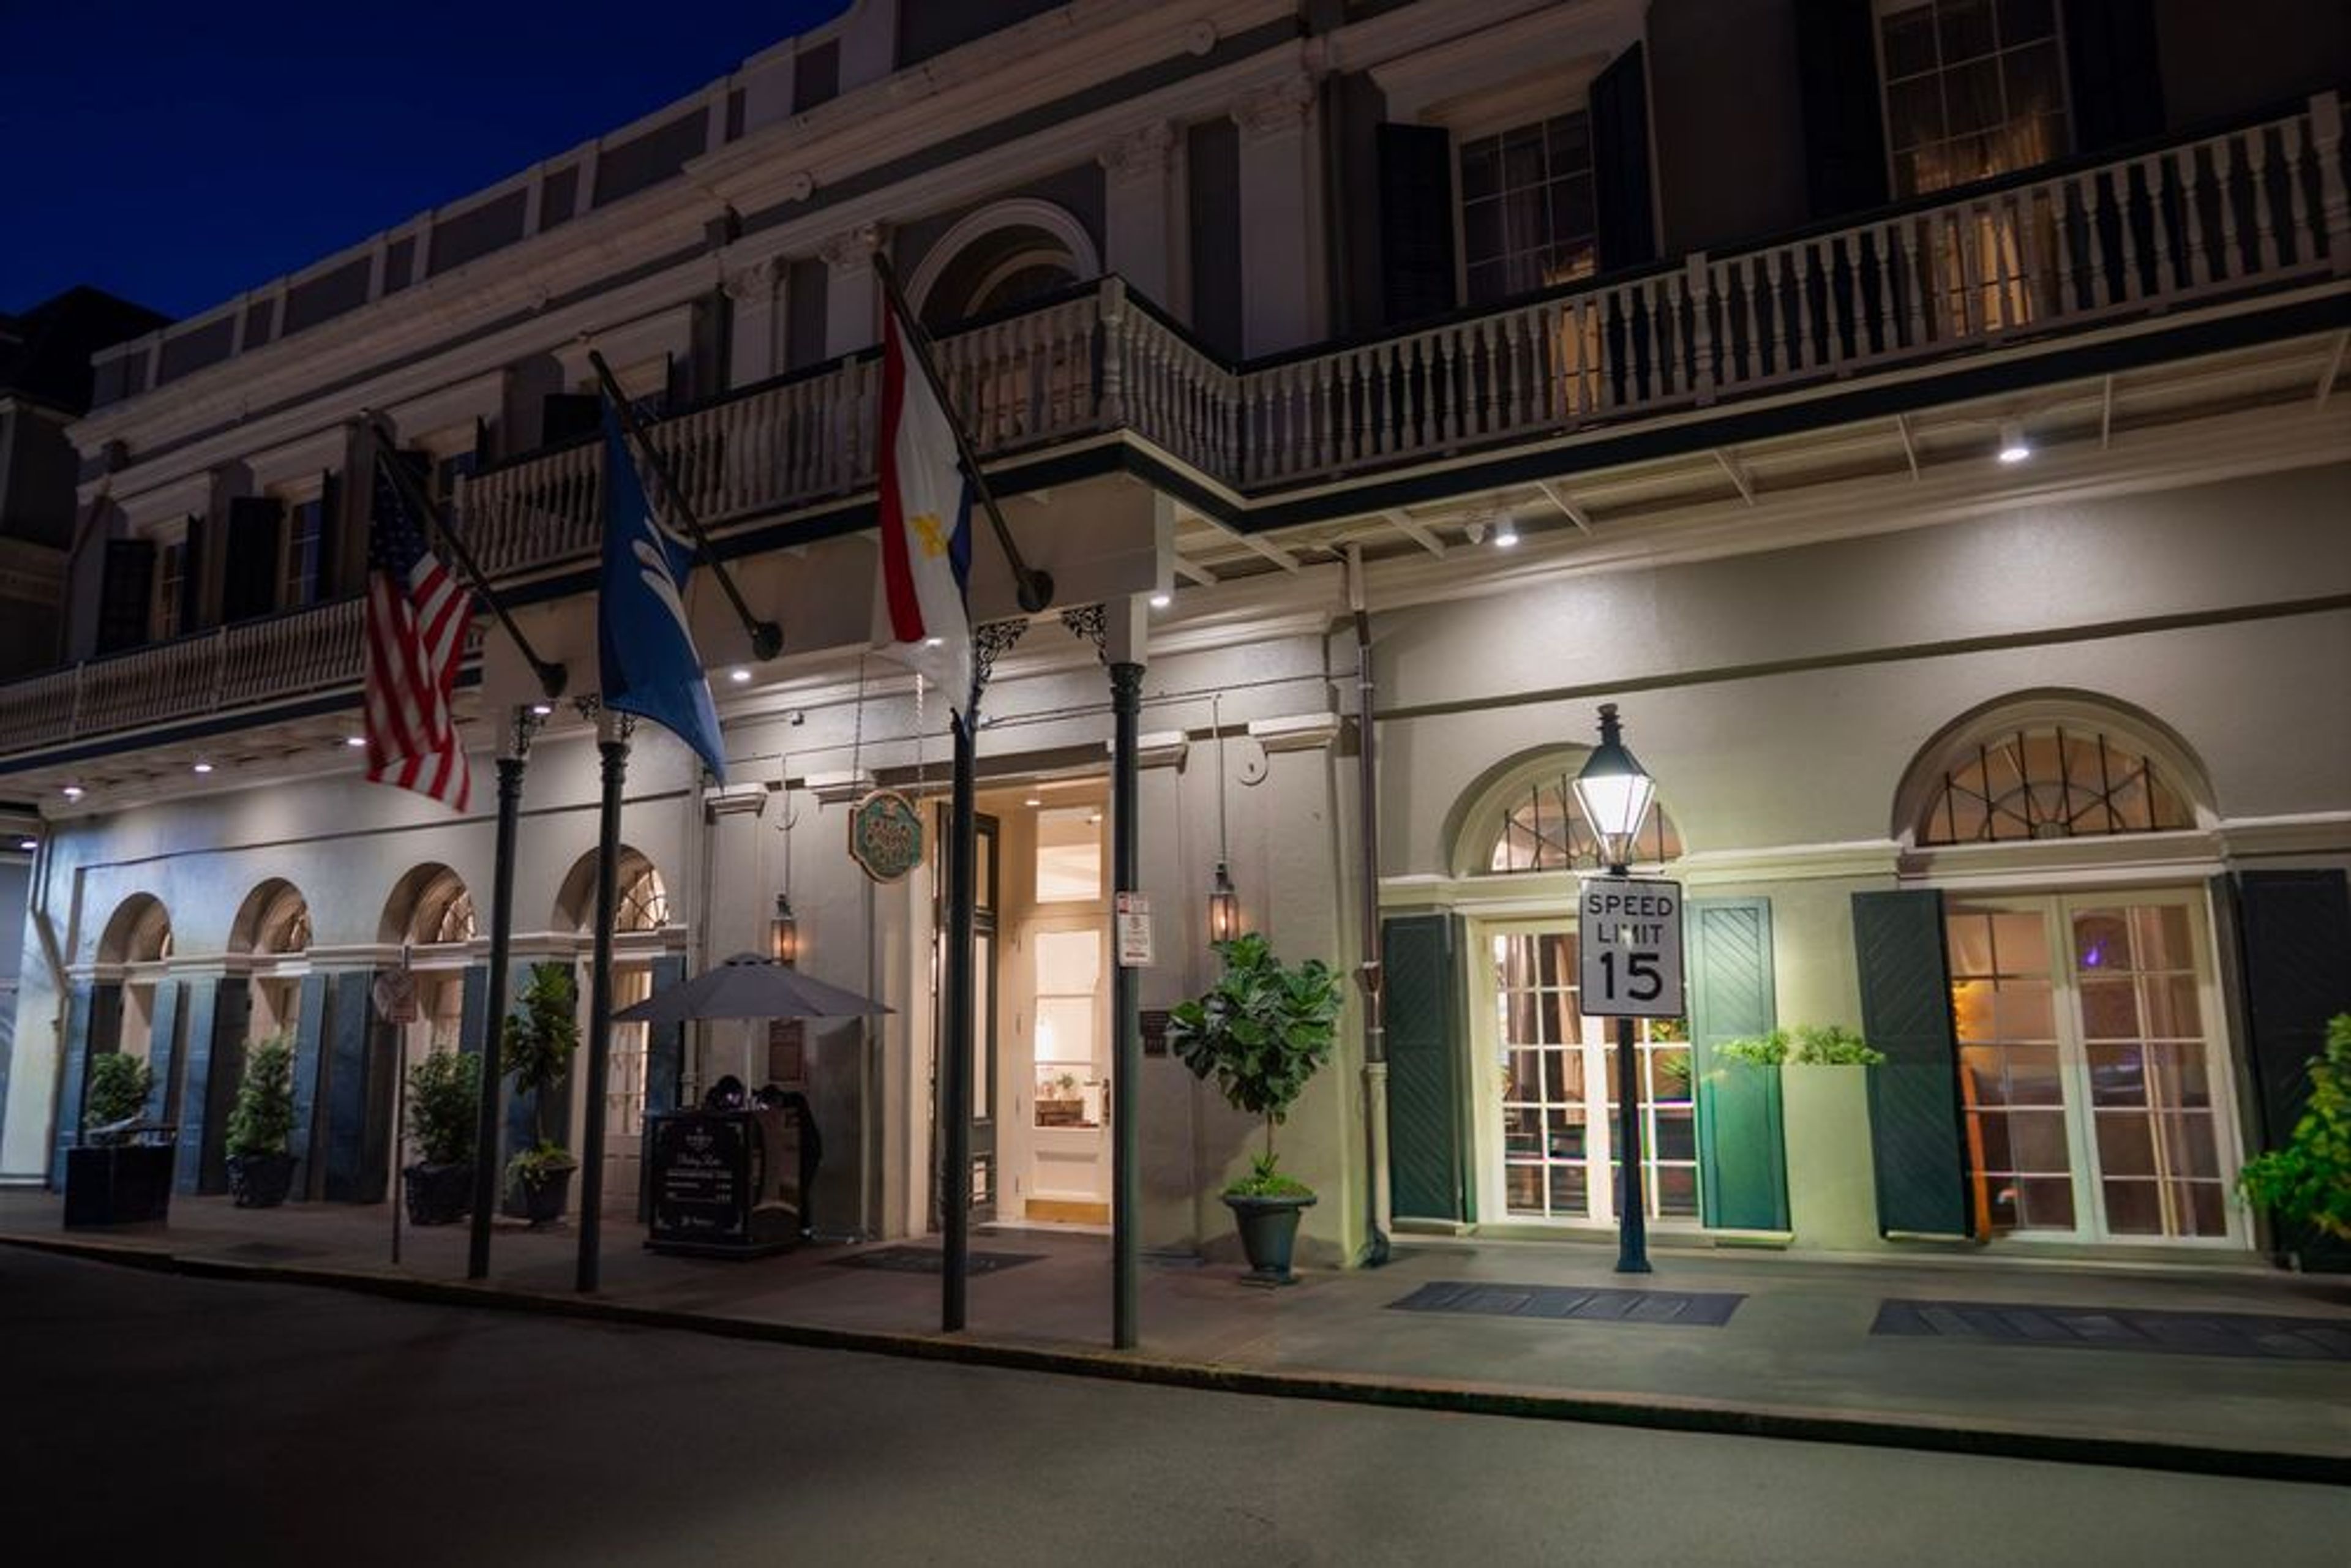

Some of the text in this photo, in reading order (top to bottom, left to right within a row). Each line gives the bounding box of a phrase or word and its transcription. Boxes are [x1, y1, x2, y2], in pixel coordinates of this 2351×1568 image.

[1588, 895, 1673, 916] SPEED
[1598, 923, 1663, 944] LIMIT
[1600, 951, 1663, 1000] 15
